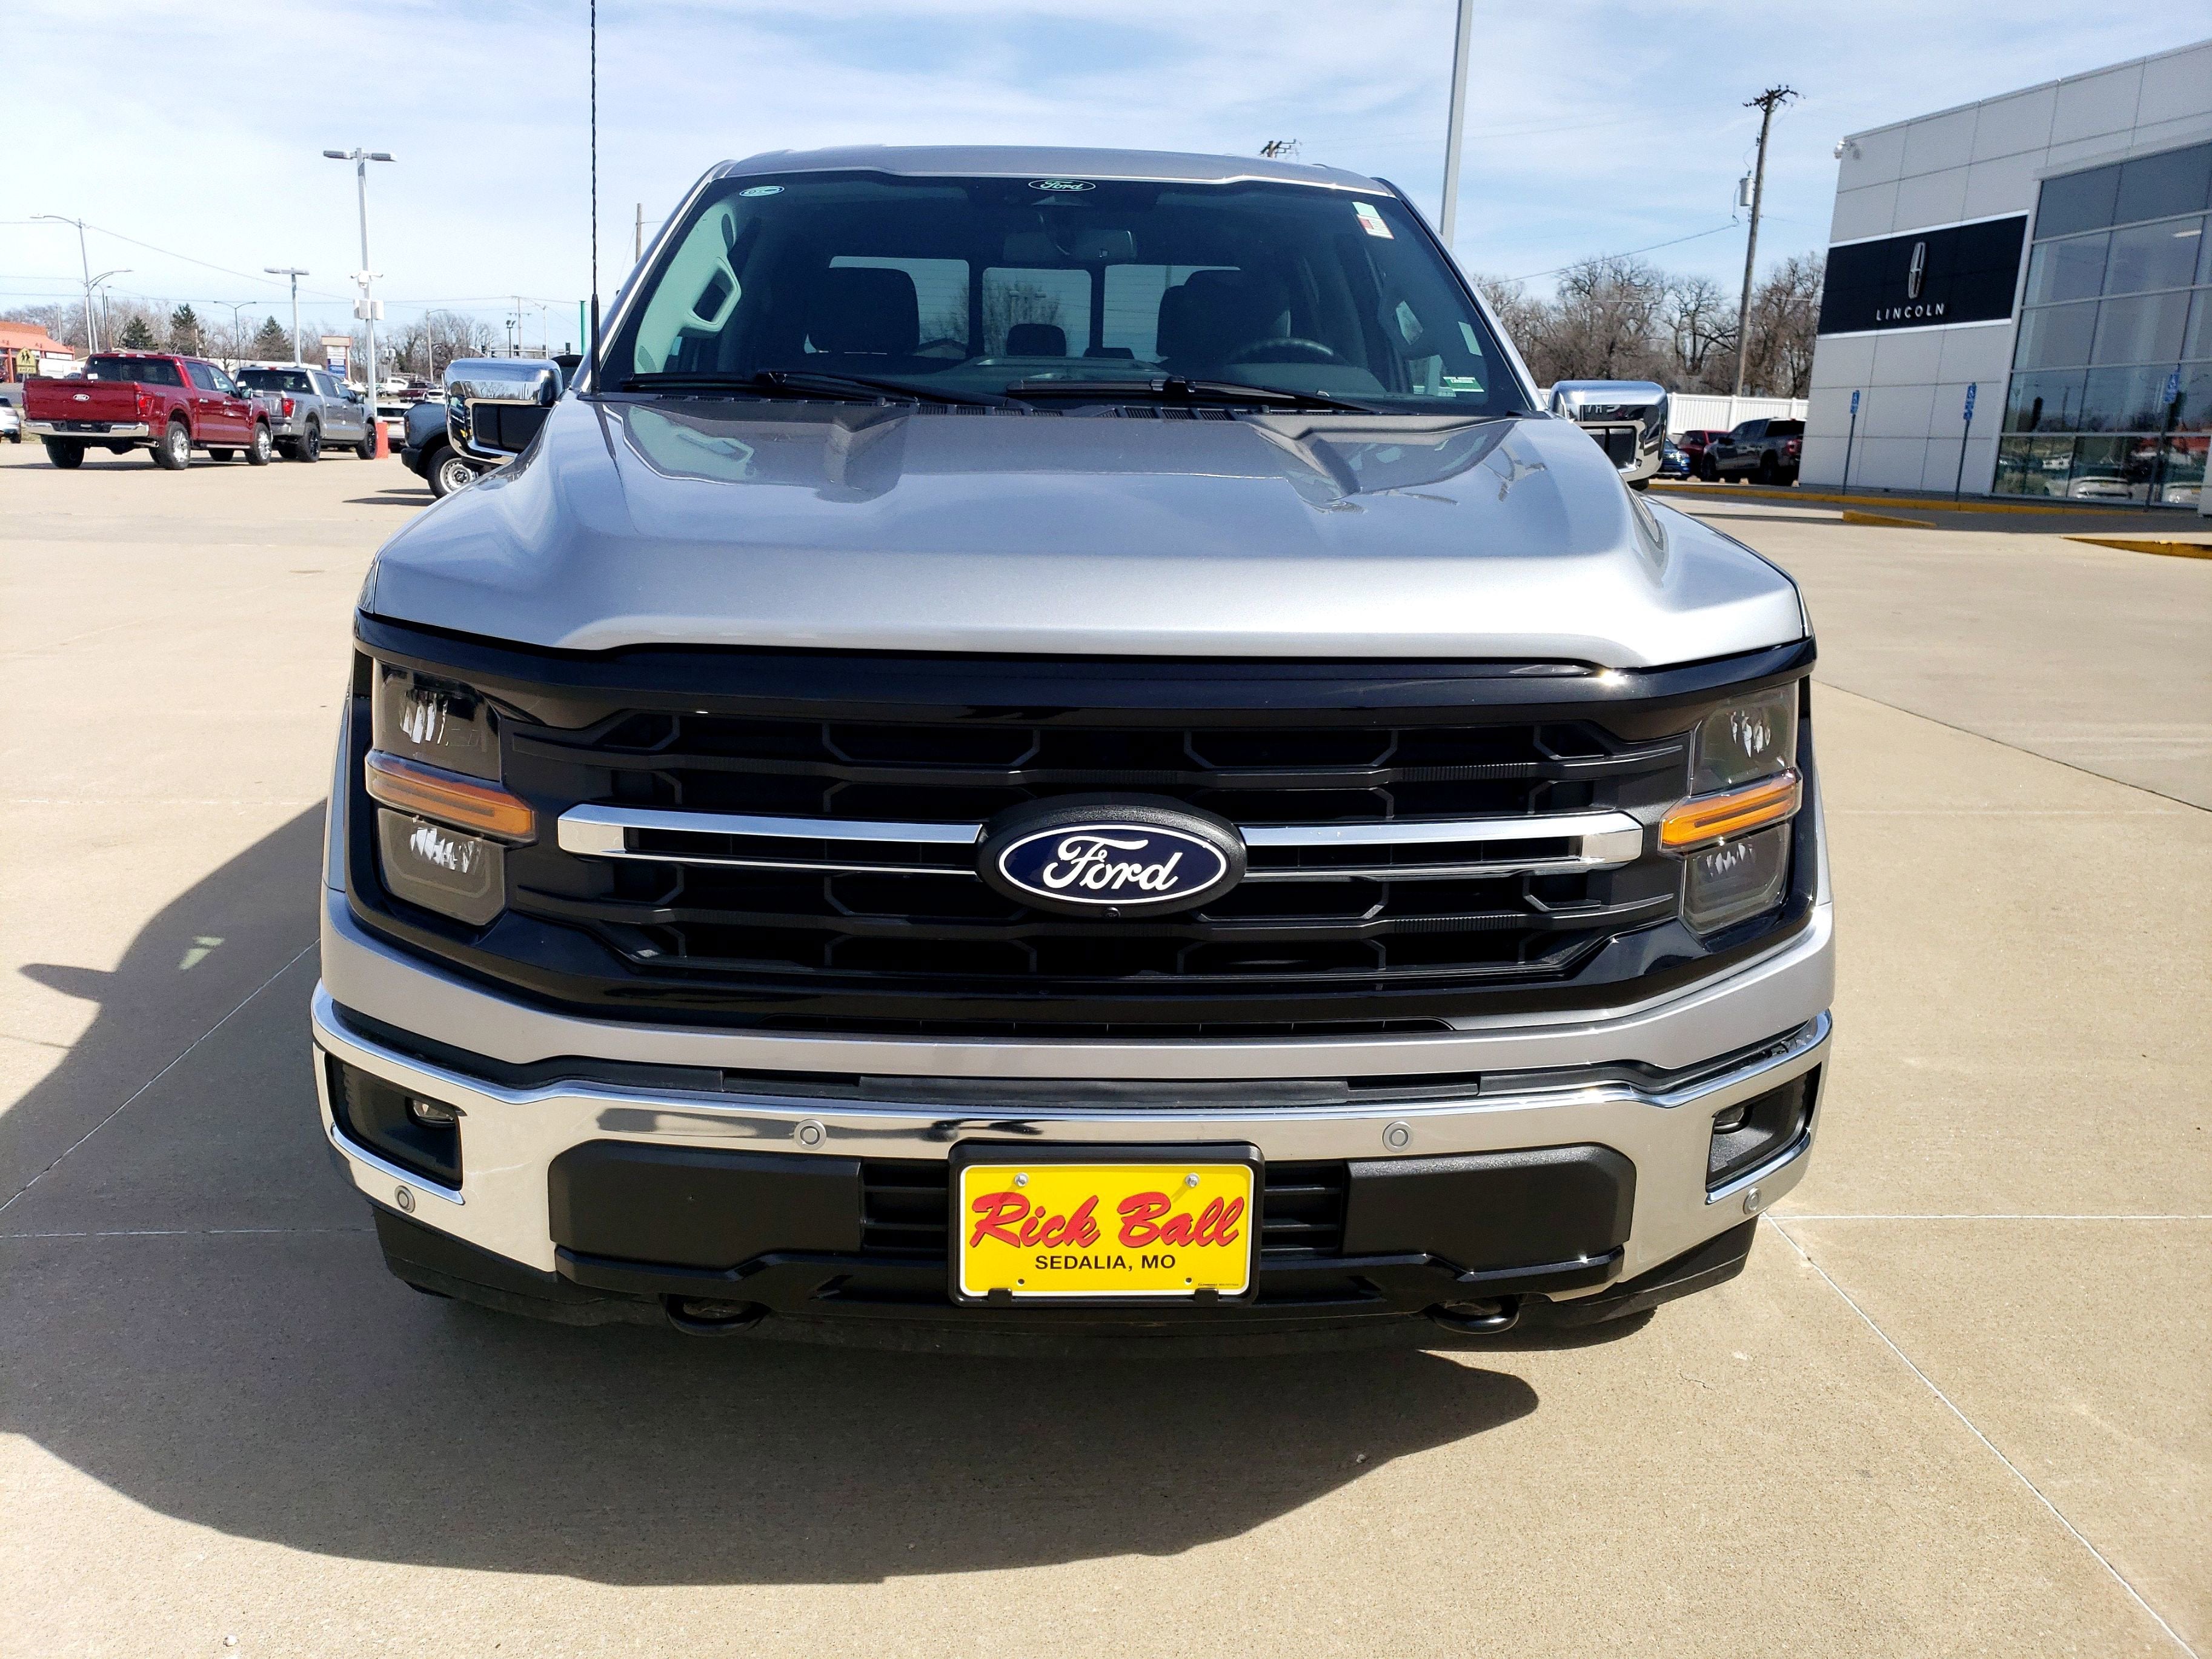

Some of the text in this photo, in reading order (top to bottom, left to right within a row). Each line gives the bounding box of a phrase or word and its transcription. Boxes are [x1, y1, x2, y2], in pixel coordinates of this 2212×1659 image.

[1040, 181, 1084, 190] Ford
[1876, 303, 1944, 321] LINCOLN
[1042, 836, 1184, 890] Ford
[969, 1191, 1244, 1248] Rick Ball
[1035, 1254, 1176, 1272] SEDALIA, MO
